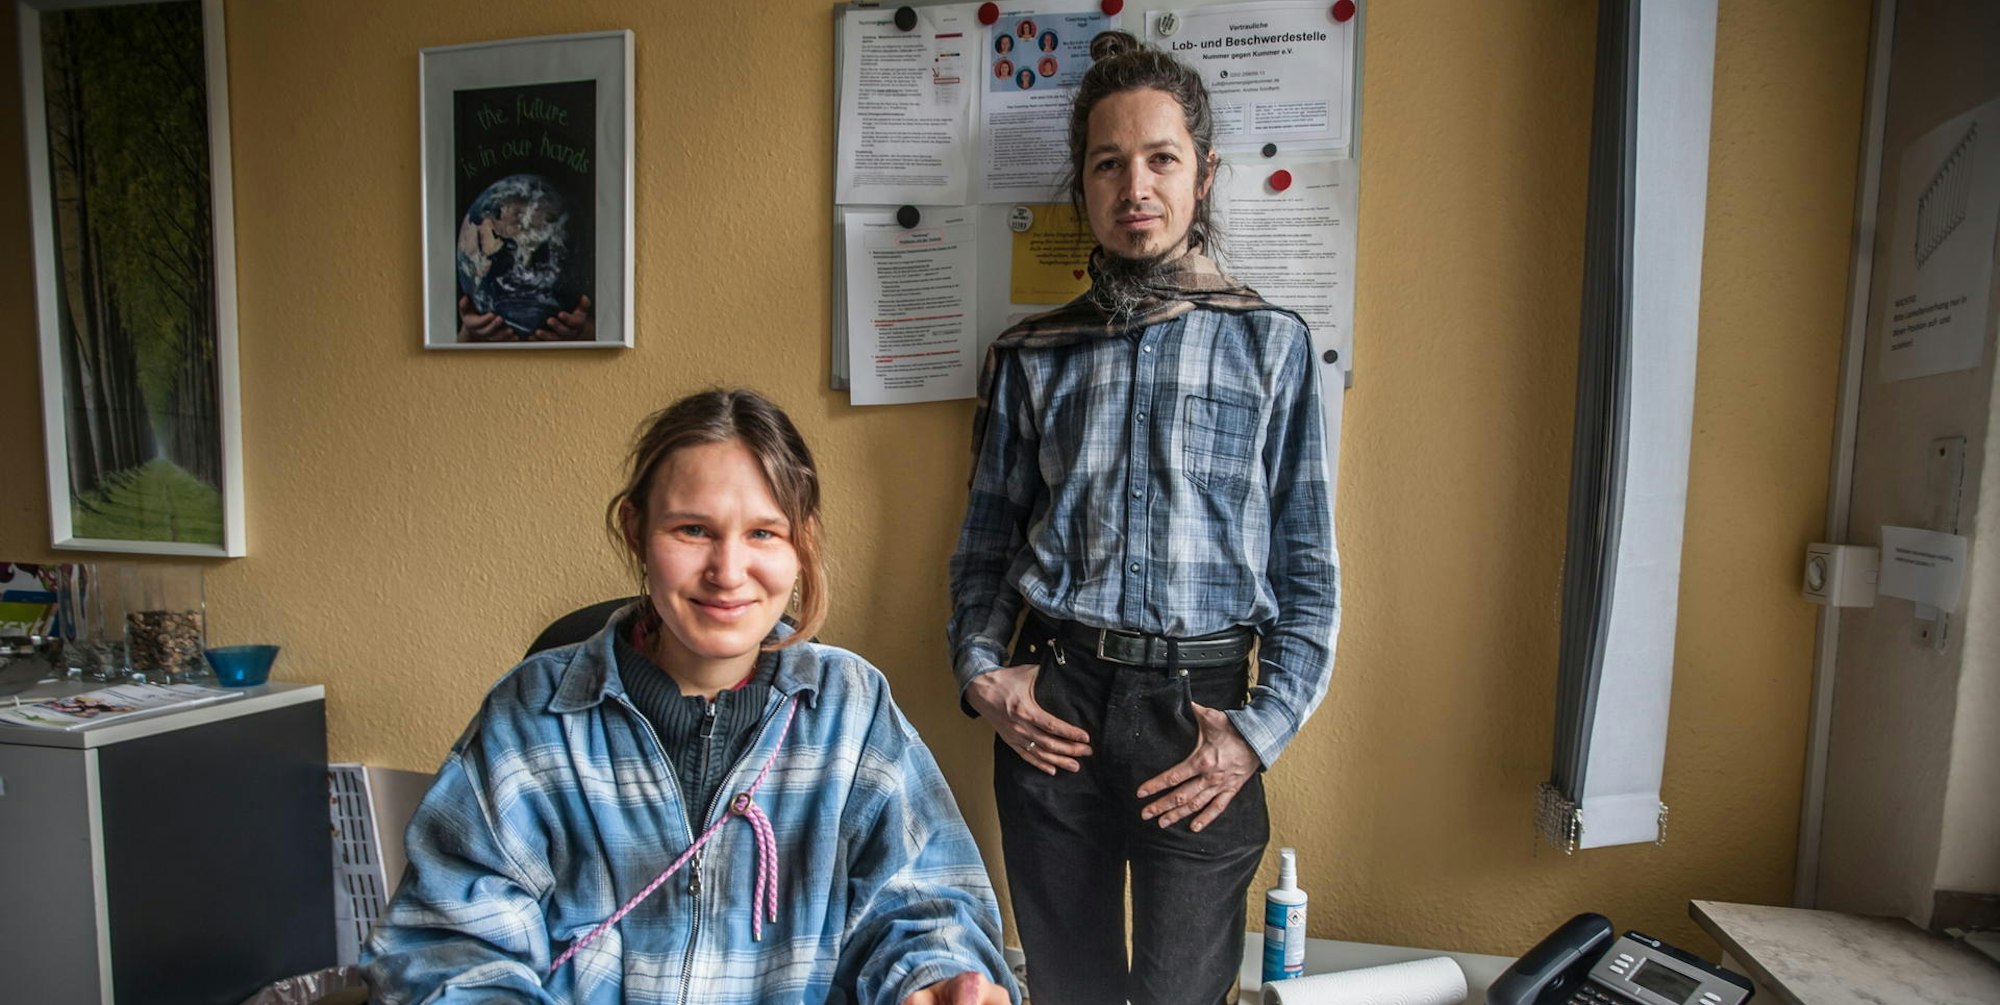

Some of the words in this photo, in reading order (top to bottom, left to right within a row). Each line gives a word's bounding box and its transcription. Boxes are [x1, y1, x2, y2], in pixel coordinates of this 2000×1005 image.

[1229, 22, 1268, 31] Vertrauliche
[1172, 40, 1198, 51] Lob-
[1200, 37, 1222, 49] und
[1225, 31, 1327, 47] Beschwerdestelle
[1231, 52, 1251, 60] gegen
[1252, 49, 1280, 57] Kummer
[476, 102, 508, 130] the
[515, 93, 569, 127] future
[460, 157, 478, 177] is
[477, 144, 498, 167] in
[501, 138, 532, 160] our
[539, 130, 590, 173] hands
